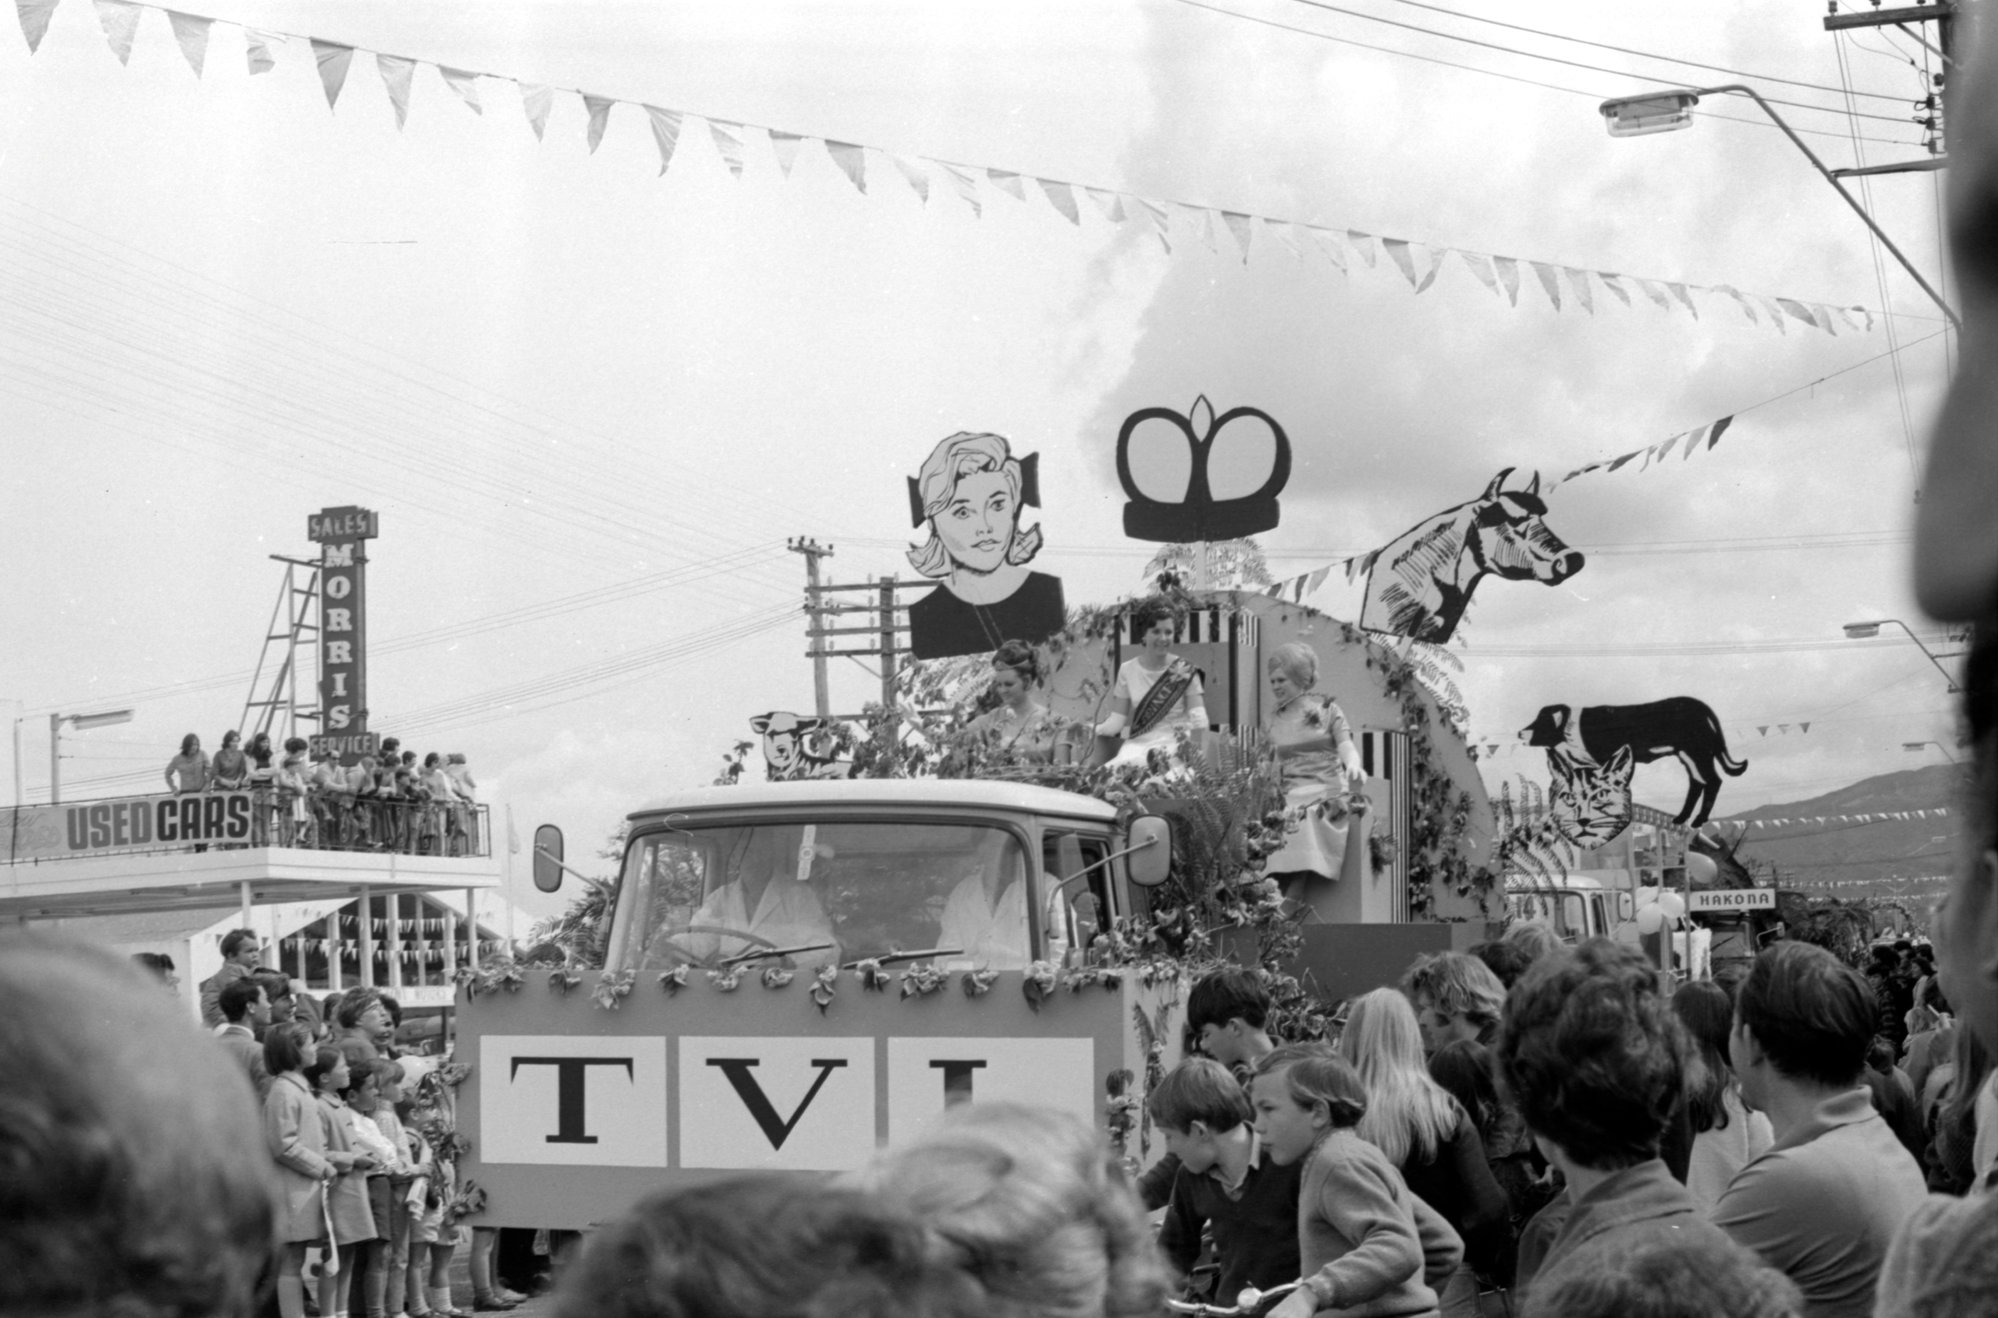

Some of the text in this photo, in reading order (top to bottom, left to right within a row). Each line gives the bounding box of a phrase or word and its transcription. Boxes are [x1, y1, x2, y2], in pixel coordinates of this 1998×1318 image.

[310, 514, 367, 538] SALES
[323, 543, 354, 731] MORRIS
[310, 735, 372, 756] SERVICE
[67, 801, 153, 851] USED
[157, 795, 250, 842] CARS
[1699, 892, 1770, 906] HAKONA
